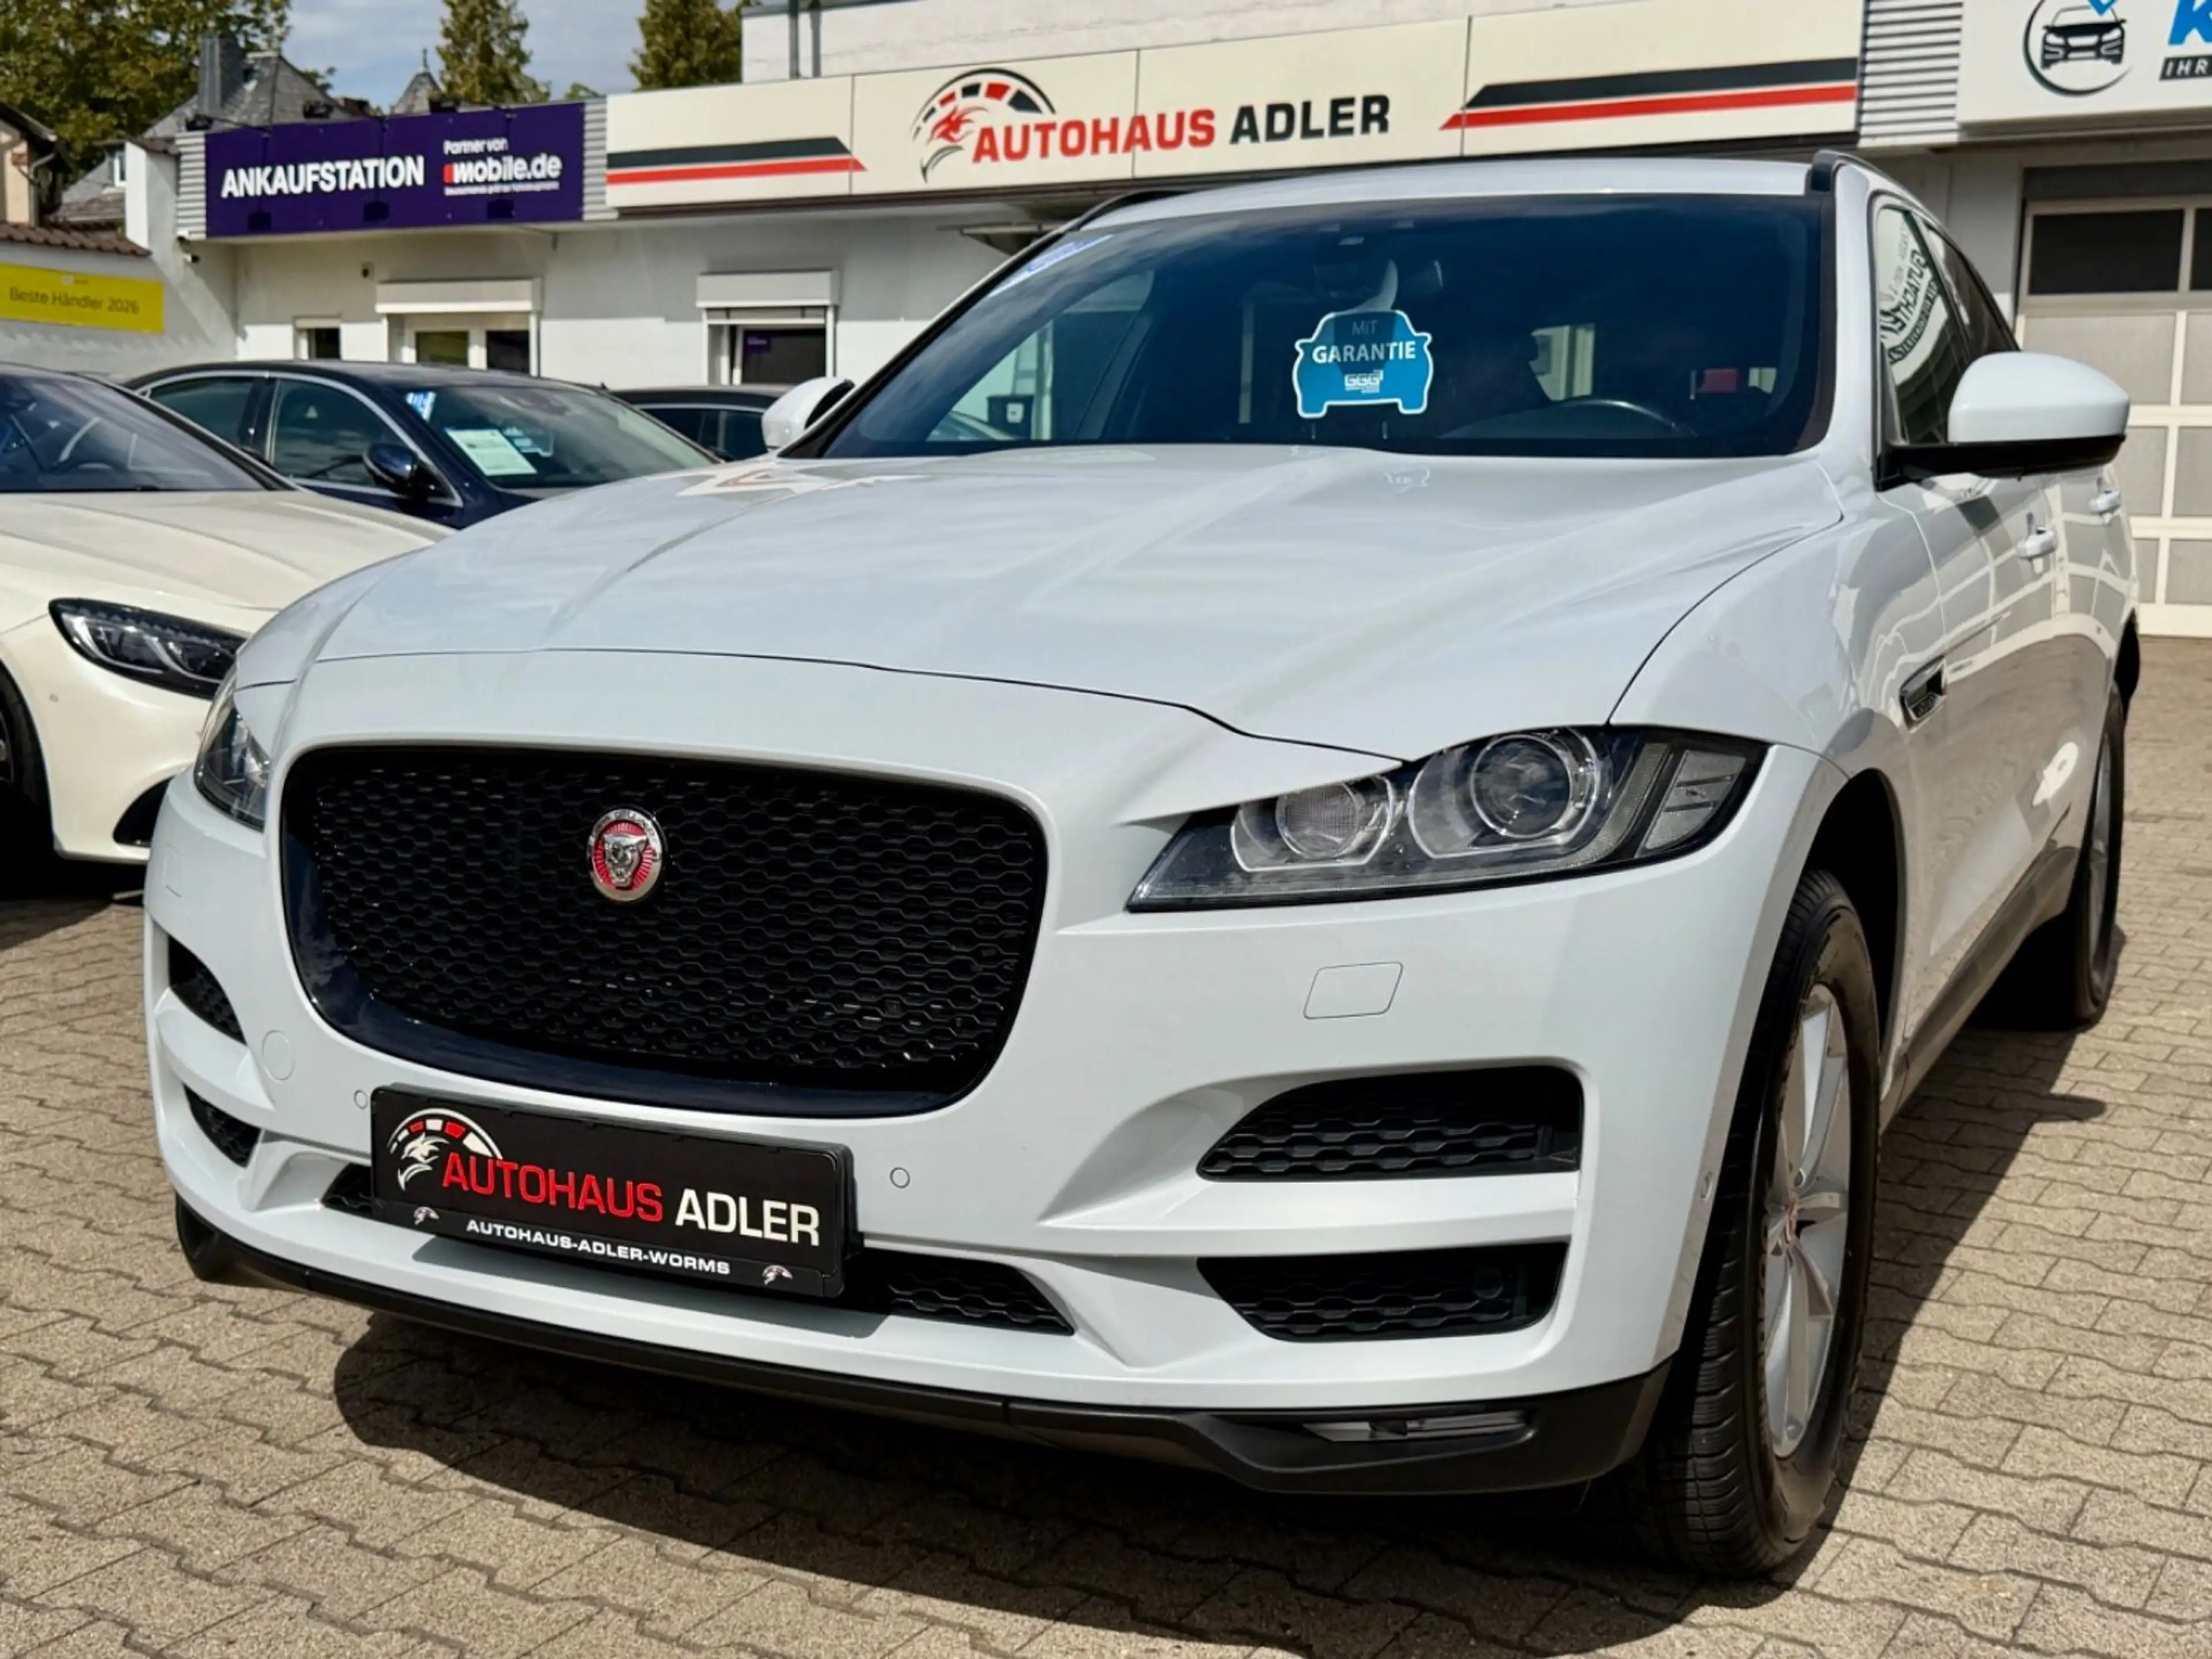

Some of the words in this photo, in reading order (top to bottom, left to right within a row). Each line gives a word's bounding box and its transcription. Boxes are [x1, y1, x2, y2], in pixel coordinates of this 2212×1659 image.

[2166, 58, 2208, 76] IHR
[973, 108, 1215, 164] AUTOHAUS
[1230, 94, 1390, 145] ADLER
[444, 140, 486, 155] Partner
[487, 138, 509, 152] von
[221, 156, 425, 198] ANKAUFSTATION
[453, 153, 562, 183] mobile.de
[10, 287, 49, 305] Beste
[52, 291, 103, 310] Händler
[1352, 320, 1378, 335] MIT
[1312, 340, 1416, 364] GARANTIE
[442, 1152, 664, 1222] AUTOHAUS
[675, 1188, 820, 1247] ADLER
[467, 1219, 730, 1275] AUTOHAUS-ADLER-WORMS
